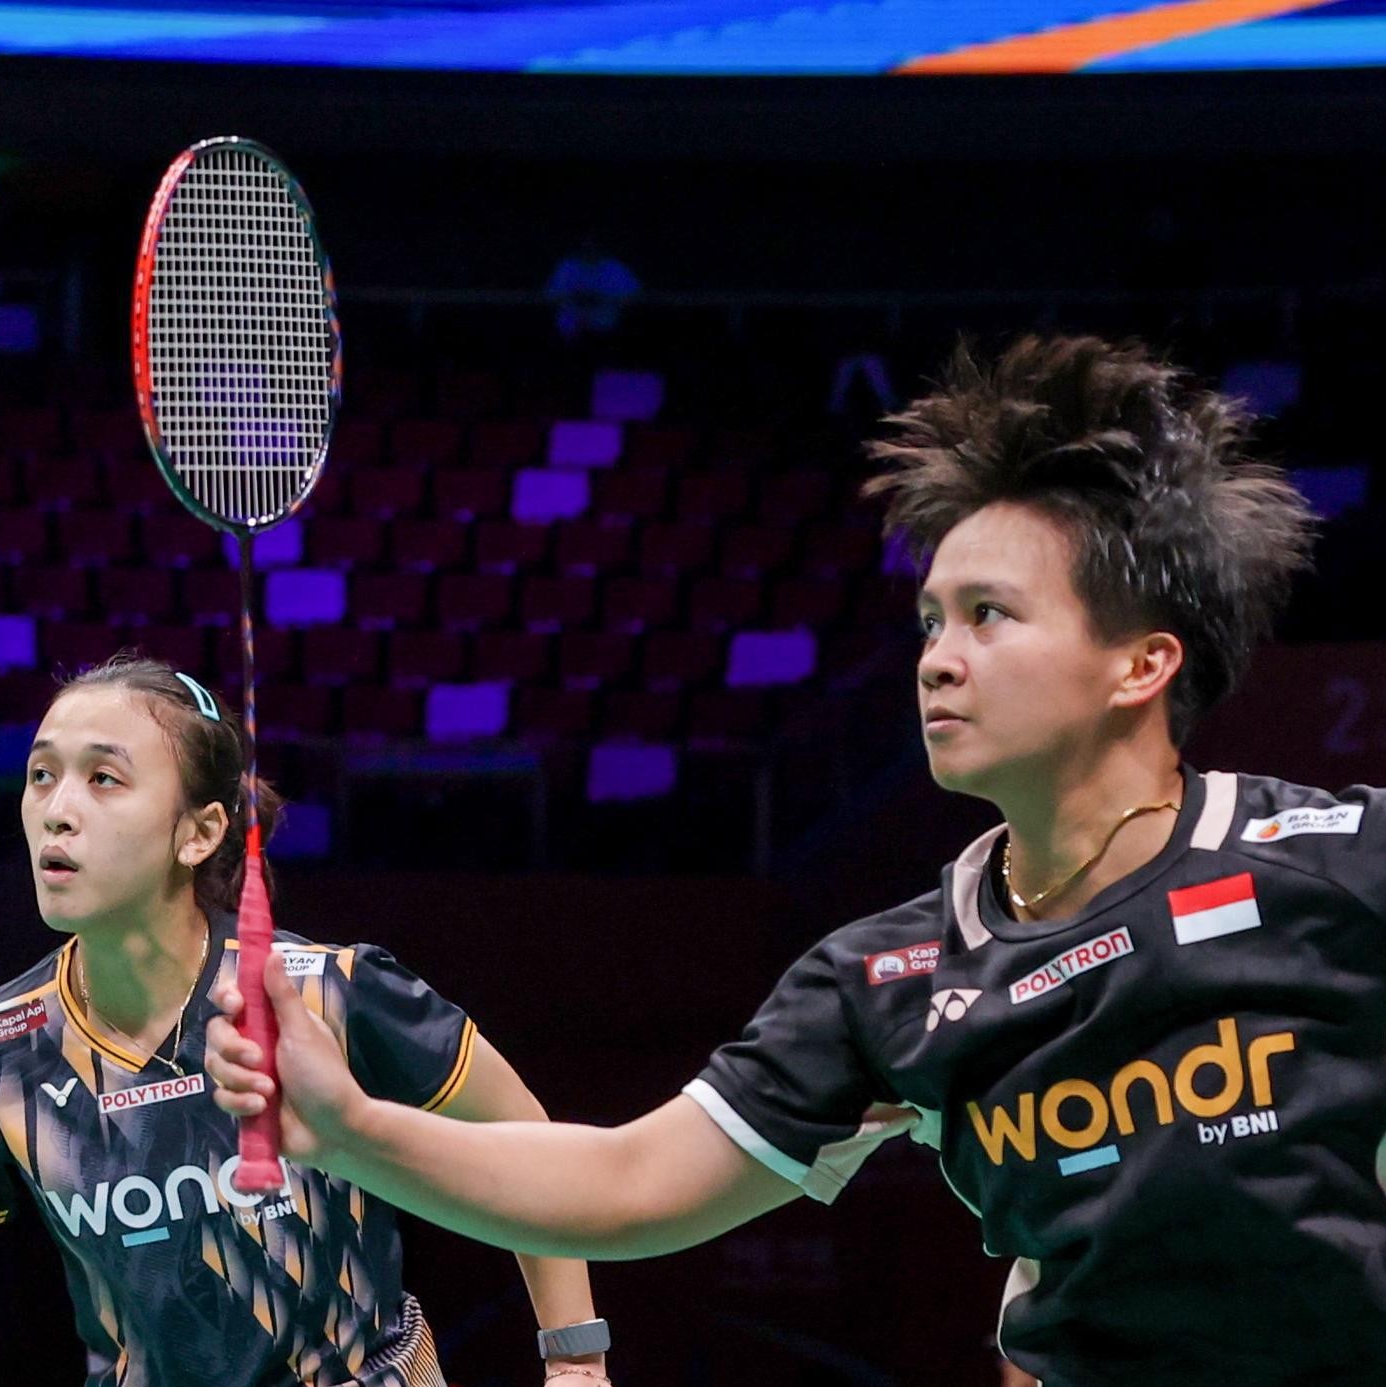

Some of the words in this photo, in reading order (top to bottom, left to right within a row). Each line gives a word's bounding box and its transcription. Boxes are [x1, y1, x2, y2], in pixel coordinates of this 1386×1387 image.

[1288, 812, 1349, 823] BAYAN
[283, 957, 316, 965] YAN
[908, 946, 940, 960] Kap
[910, 959, 938, 970] Gro
[1015, 932, 1130, 1000] POLYTRON
[26, 1003, 45, 1019] Api
[102, 1076, 203, 1111] POLYTRON
[966, 1017, 1295, 1166] wondr
[1198, 1122, 1228, 1145] by
[1231, 1109, 1279, 1138] BNI
[239, 1208, 262, 1227] by
[264, 1199, 299, 1222] BNI
